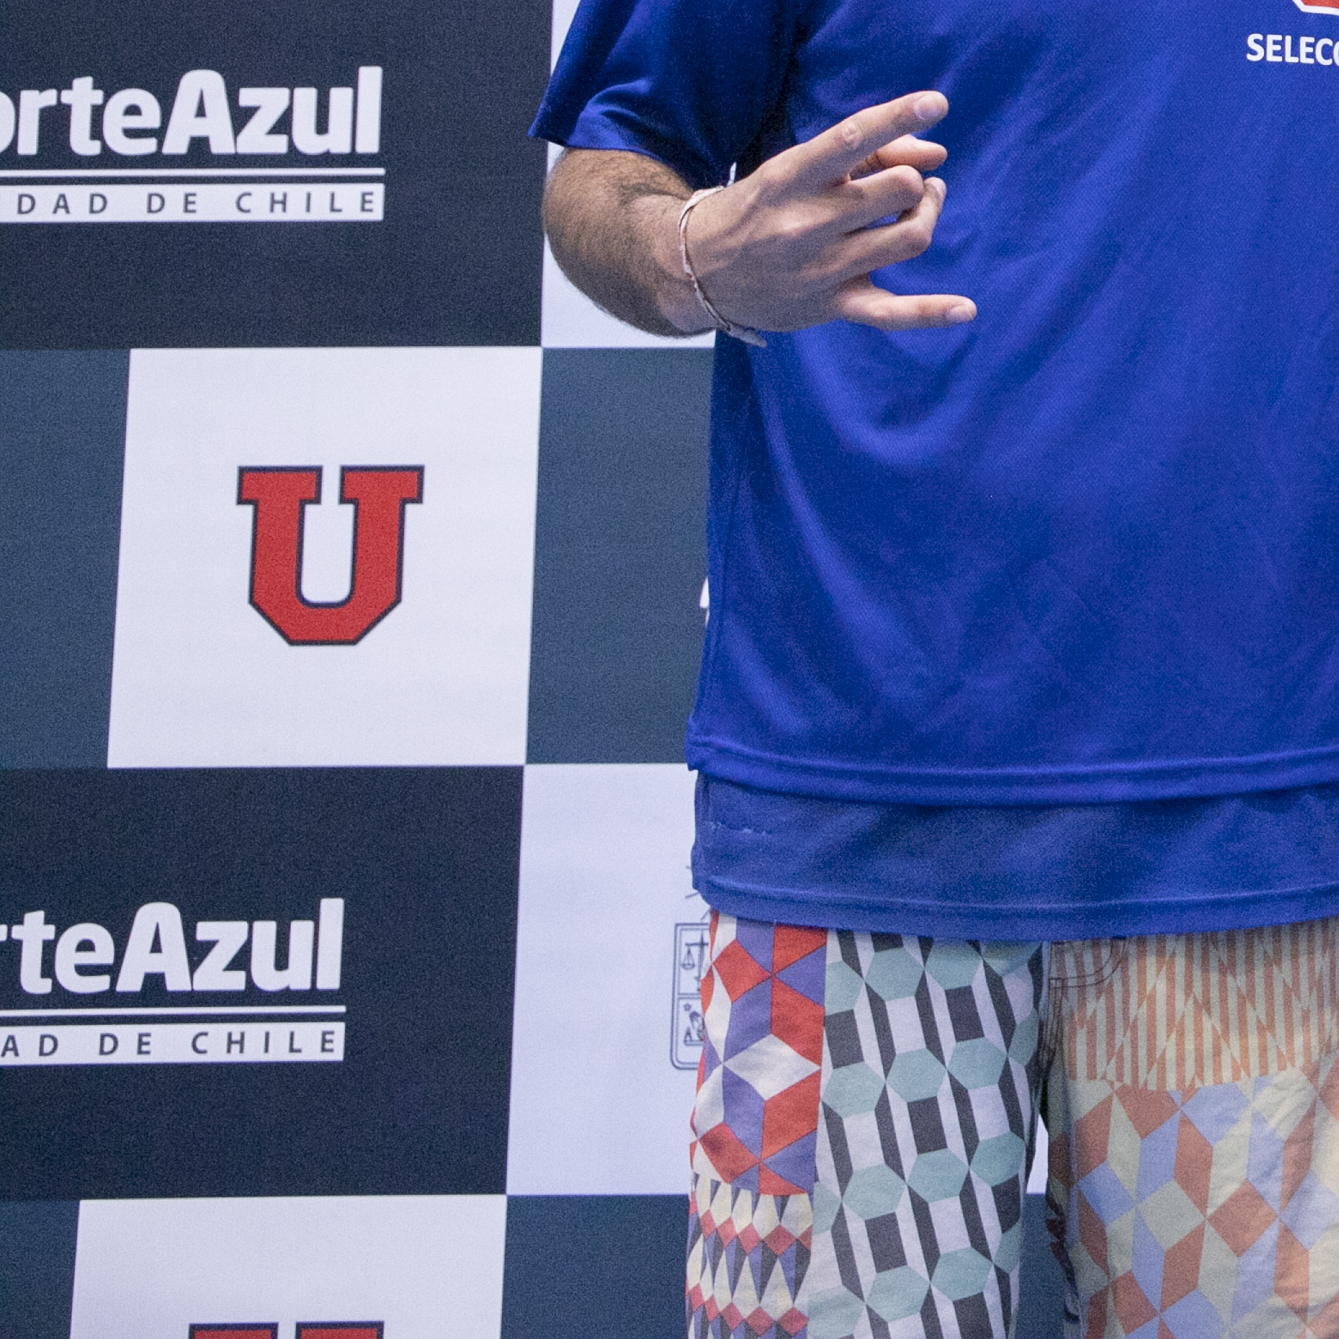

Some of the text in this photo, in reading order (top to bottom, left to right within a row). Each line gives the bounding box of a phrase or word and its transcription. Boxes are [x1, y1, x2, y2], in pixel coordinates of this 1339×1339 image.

[0, 66, 383, 156] rteAzul
[147, 191, 374, 214] DE CHILE
[236, 465, 425, 646] U
[0, 897, 344, 994] teAzul
[99, 1030, 335, 1056] DE CHILE
